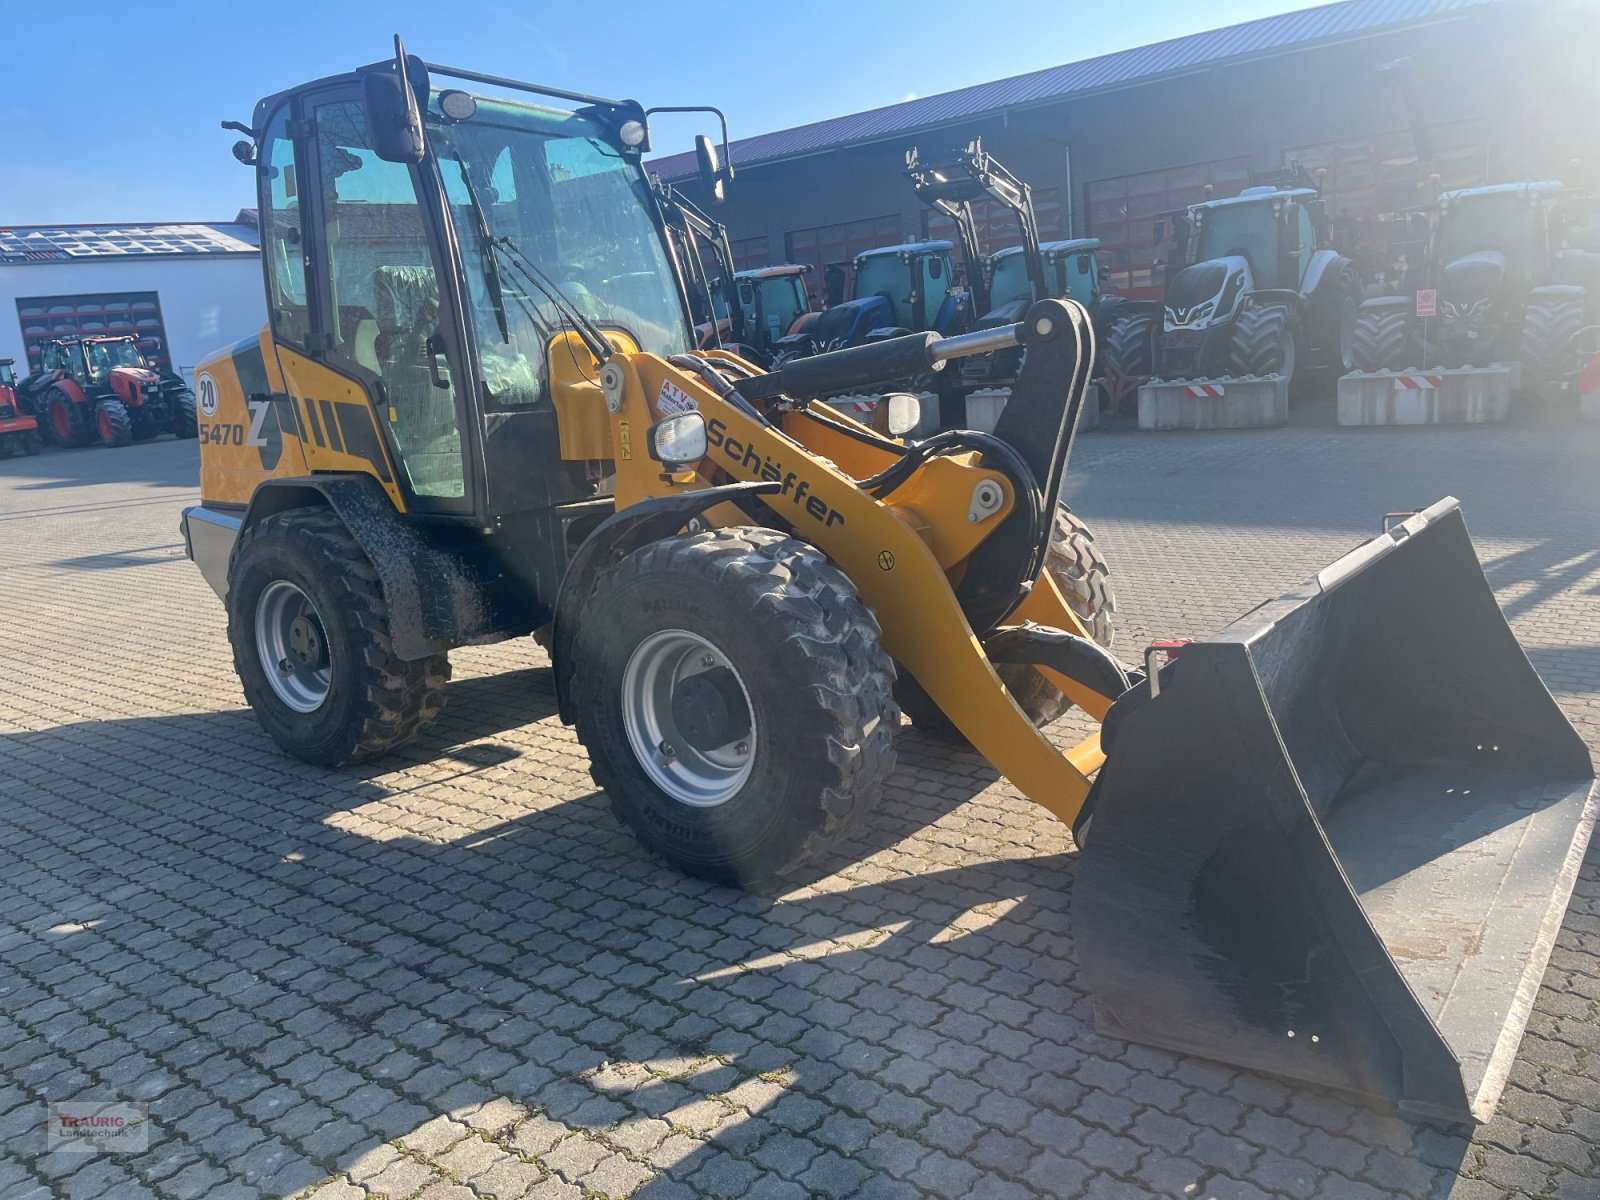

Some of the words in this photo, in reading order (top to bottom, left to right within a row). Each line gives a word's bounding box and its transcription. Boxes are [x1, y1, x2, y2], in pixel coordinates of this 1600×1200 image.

[201, 380, 214, 408] 20
[200, 423, 244, 446] 5470
[246, 401, 270, 447] Z
[707, 417, 846, 529] Schäffer
